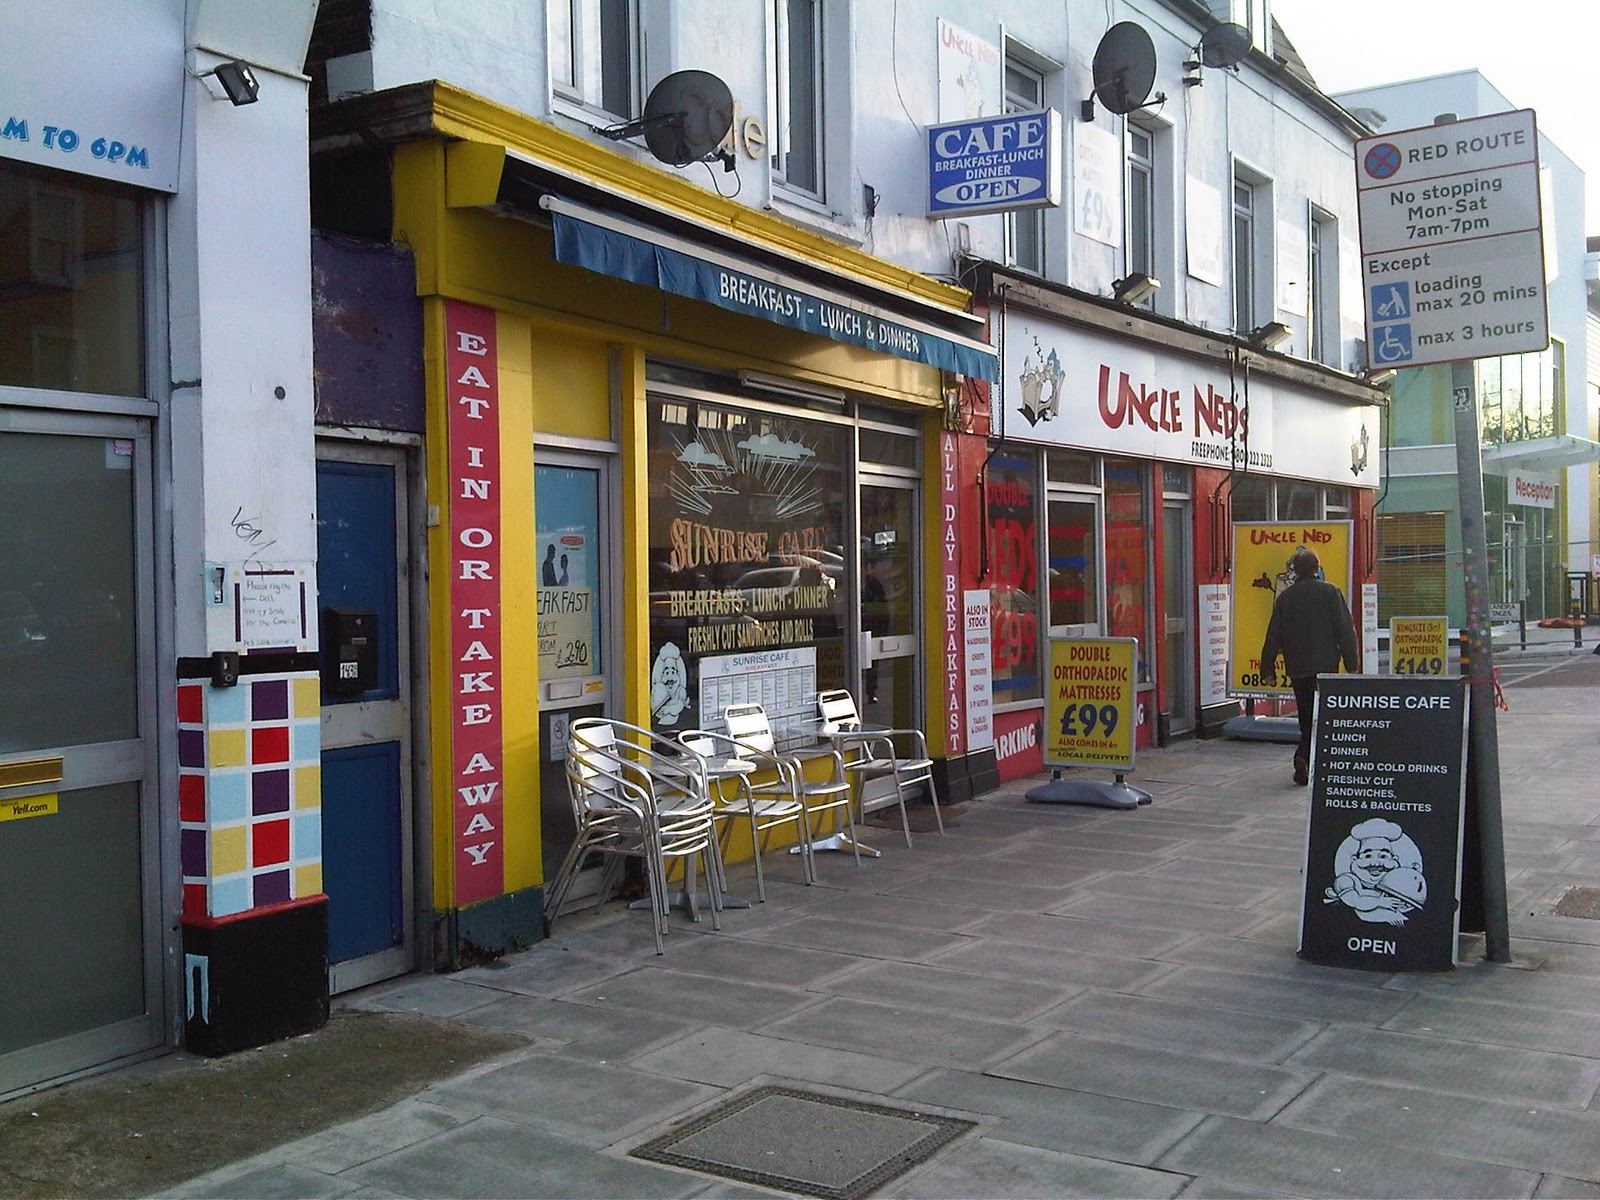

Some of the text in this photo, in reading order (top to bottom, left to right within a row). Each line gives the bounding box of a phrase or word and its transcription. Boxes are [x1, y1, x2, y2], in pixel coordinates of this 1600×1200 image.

[0, 116, 149, 168] M TO 6PM
[935, 118, 1044, 158] CAFE
[1408, 130, 1525, 163] RED ROUTE
[935, 149, 1043, 172] BREAKFAST-LUNCH
[966, 165, 1011, 180] DINNER
[956, 179, 1020, 200] OPEN
[1390, 177, 1503, 205] No stopping
[1408, 196, 1488, 221] Mon-Sat
[1406, 216, 1489, 240] 7am-7pm
[1369, 252, 1431, 274] Except
[1415, 274, 1482, 294] loading
[1416, 285, 1537, 313] max 20 mins
[719, 272, 801, 319] BREAKFAST
[820, 304, 861, 336] LUNCH
[866, 320, 875, 340] &
[879, 323, 919, 354] DINNER
[1417, 320, 1535, 346] max 3 hours
[1098, 364, 1249, 442] UNCLE NED'S
[1515, 476, 1554, 501] Reception
[670, 518, 827, 573] SUNRISE CAFE
[1250, 529, 1332, 545] UNCLE NED
[457, 331, 498, 865] EAT IN OR TAKE AWAY
[670, 588, 743, 617] BREAKFASTS
[752, 587, 786, 612] LUNCH
[794, 586, 828, 609] DINNER
[944, 435, 959, 751] ALL DAY BREAKFAST
[966, 605, 980, 615] ALSO
[982, 605, 988, 615] IN
[968, 617, 986, 628] STOCK
[688, 618, 813, 653] FRESHLY CUT SANDWICHES AND ROLLS
[1395, 634, 1442, 644] ORTHOPAEDIC
[733, 655, 768, 667] SUNRISE
[1070, 646, 1111, 662] DOUBLE
[1054, 665, 1128, 682] ORTHOPAEDIC
[1394, 657, 1443, 675] £149
[1059, 685, 1121, 700] MATTRESSES
[1326, 696, 1451, 709] SUNRISE CAFE
[1060, 703, 1119, 738] £99
[1333, 719, 1391, 729] BREAKFAST
[1058, 738, 1074, 747] ALSO
[1076, 738, 1098, 747] COMES
[1100, 740, 1108, 748] IN
[1332, 733, 1366, 742] LUNCH
[1330, 747, 1368, 756] DINNER
[1330, 761, 1448, 774] HOT AND COLD DRINKS
[1327, 775, 1394, 785] FRESHLY CUT
[1326, 787, 1397, 799] SANDWICHES,
[13, 804, 48, 815] Yell.com
[1326, 799, 1432, 812] ROLLS & BAGUETTES
[1347, 937, 1396, 954] OPEN
